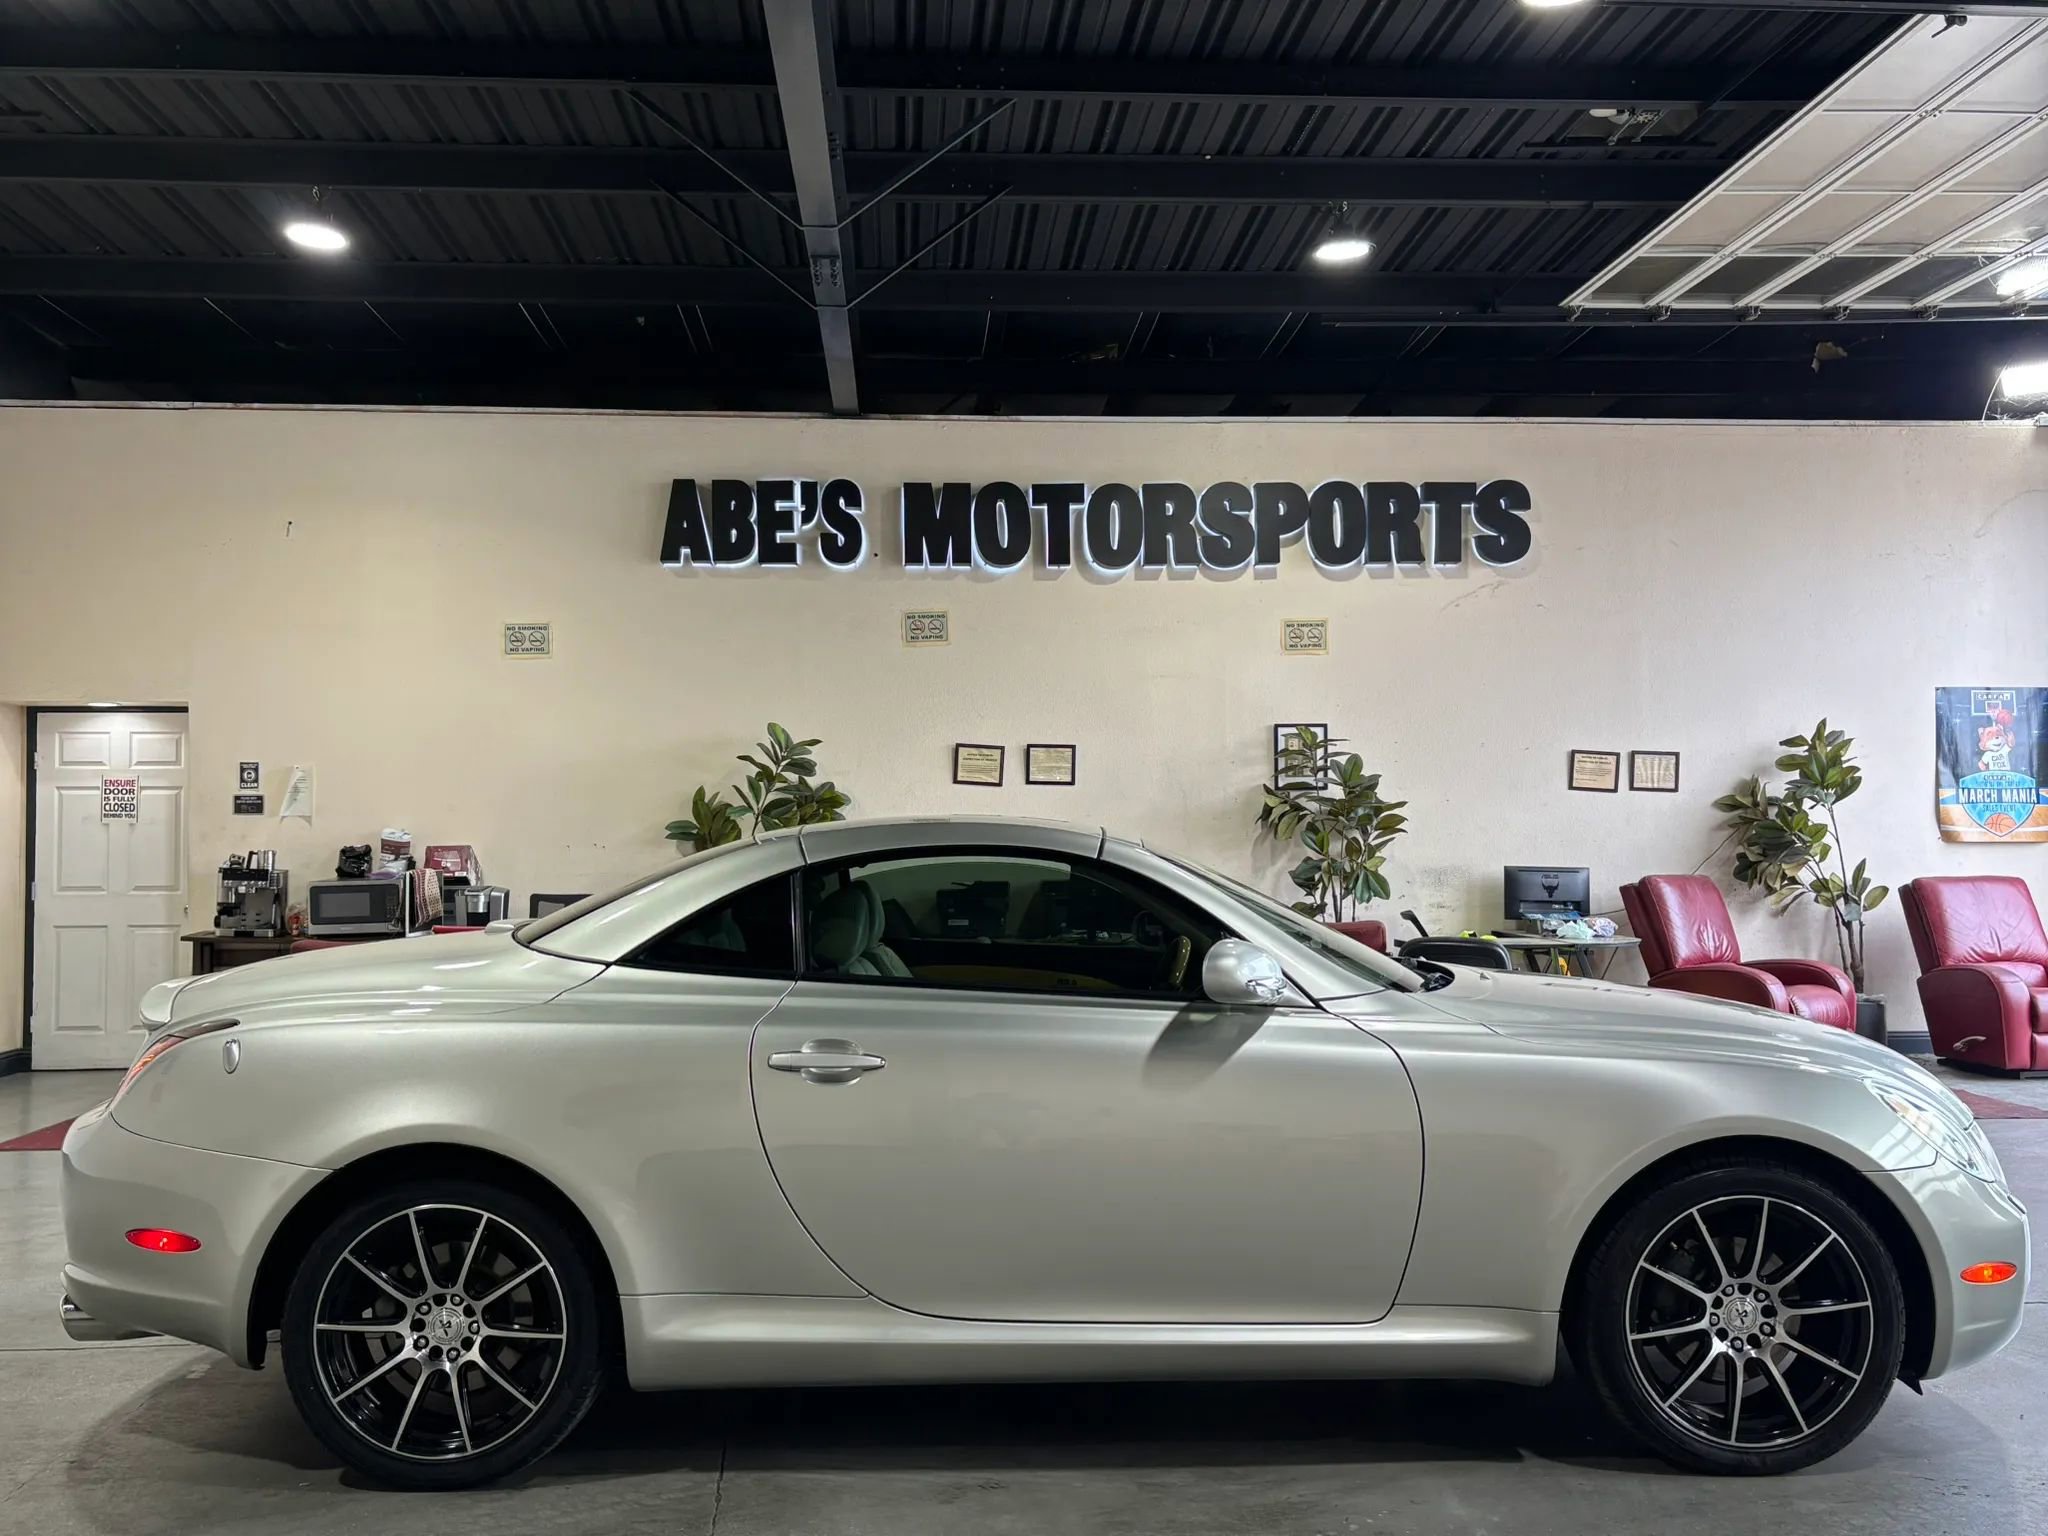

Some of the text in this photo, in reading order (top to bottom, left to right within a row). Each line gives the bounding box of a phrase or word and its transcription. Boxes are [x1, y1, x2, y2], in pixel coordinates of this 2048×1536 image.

[660, 478, 1532, 568] ABE'S MOTORSPORTS
[104, 779, 136, 787] ENSURE
[1959, 788, 2037, 803] MARCH MANIA
[104, 803, 135, 812] CLOSED
[1983, 804, 1999, 812] SALES
